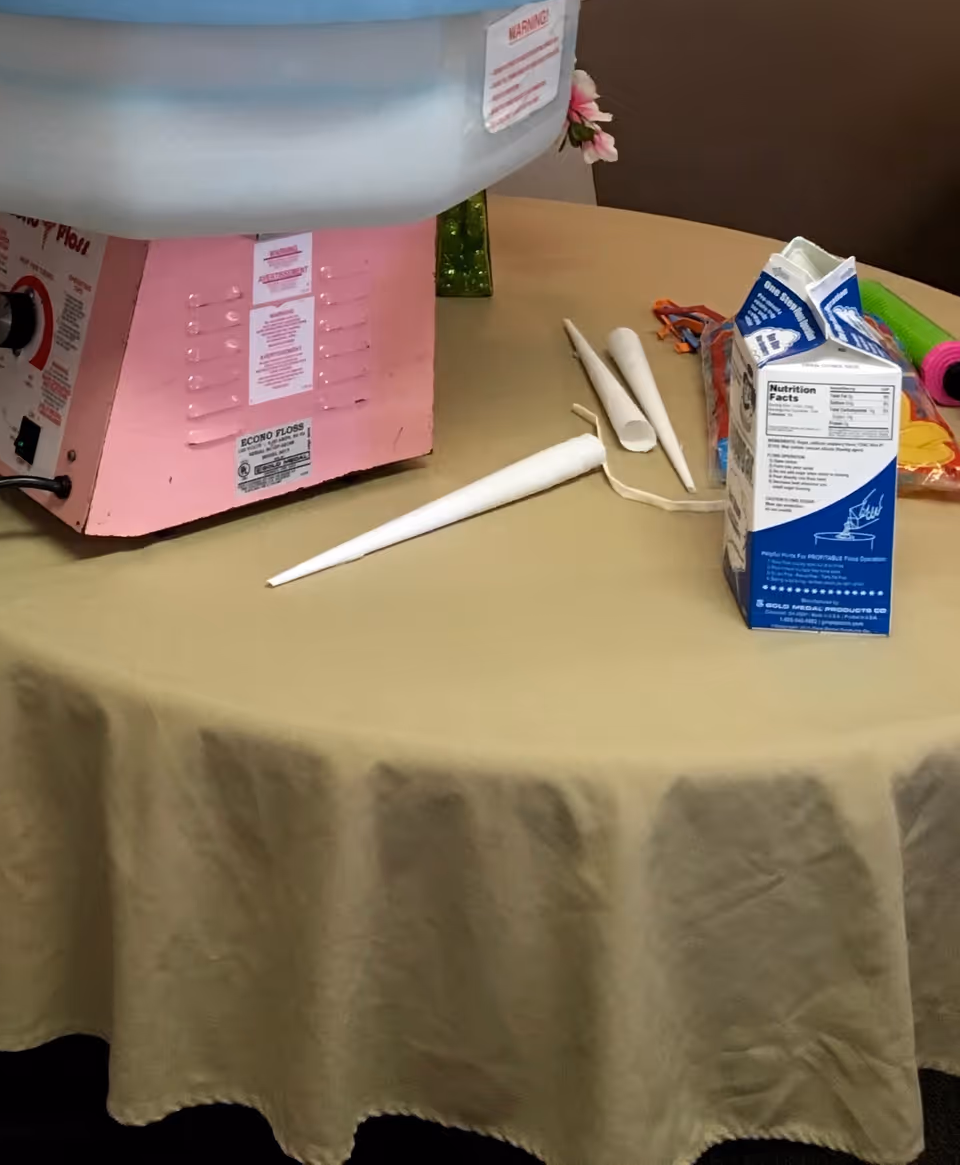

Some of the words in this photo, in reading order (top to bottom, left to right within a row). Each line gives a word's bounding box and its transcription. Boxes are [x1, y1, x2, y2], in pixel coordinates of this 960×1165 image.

[508, 8, 549, 41] WARNING!
[764, 280, 782, 296] One
[779, 290, 802, 311] Step
[769, 384, 817, 394] Nutrition
[769, 393, 799, 403] Facts
[241, 431, 273, 447] ECONO
[275, 422, 304, 438] FLOSS
[765, 602, 790, 610] GOLD
[792, 604, 822, 612] MEDAL
[824, 606, 872, 614] PRODUCTS
